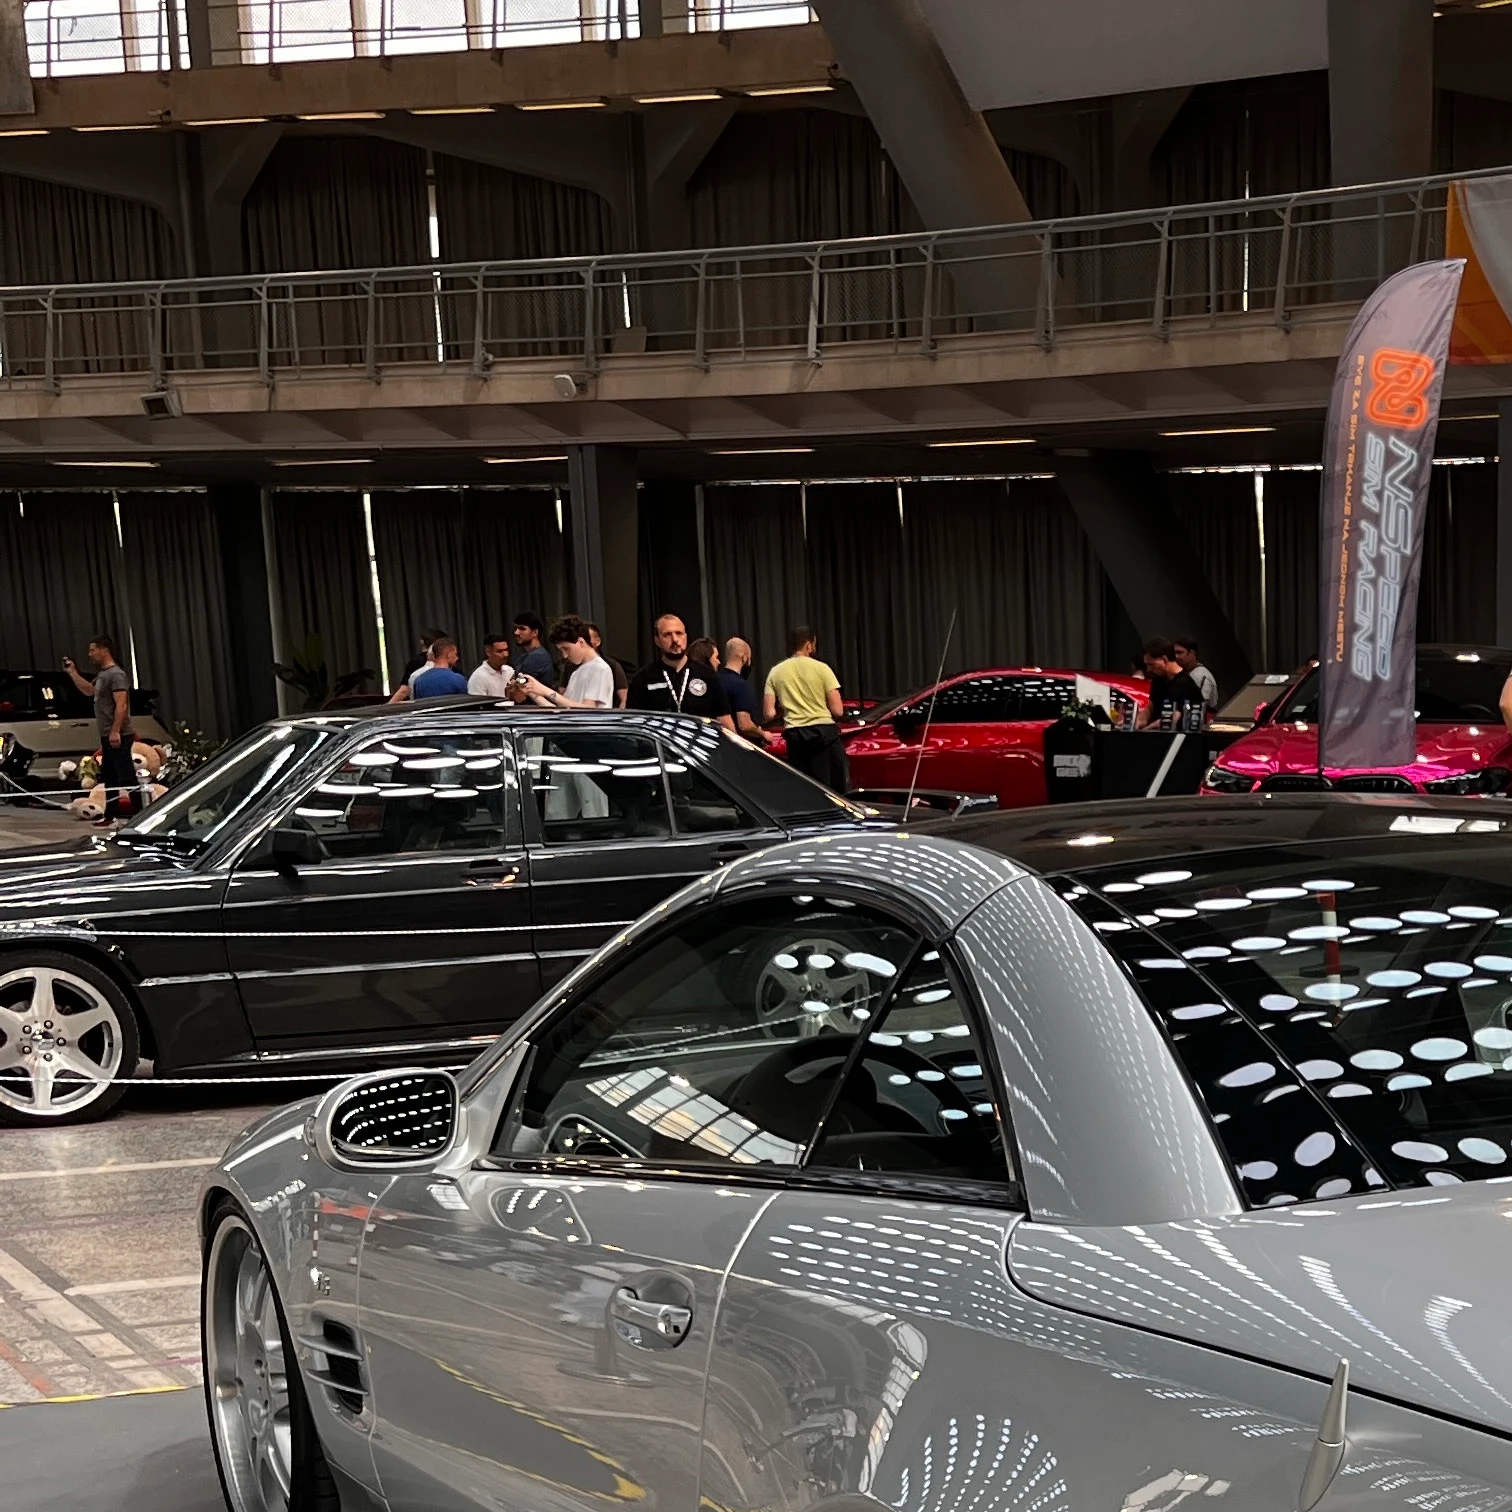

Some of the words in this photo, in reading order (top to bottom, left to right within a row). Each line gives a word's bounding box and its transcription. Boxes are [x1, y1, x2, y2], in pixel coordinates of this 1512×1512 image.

[1361, 430, 1386, 514] SIM
[1341, 518, 1350, 542] NA
[1352, 519, 1379, 683] RACING
[1335, 610, 1345, 663] MESTU
